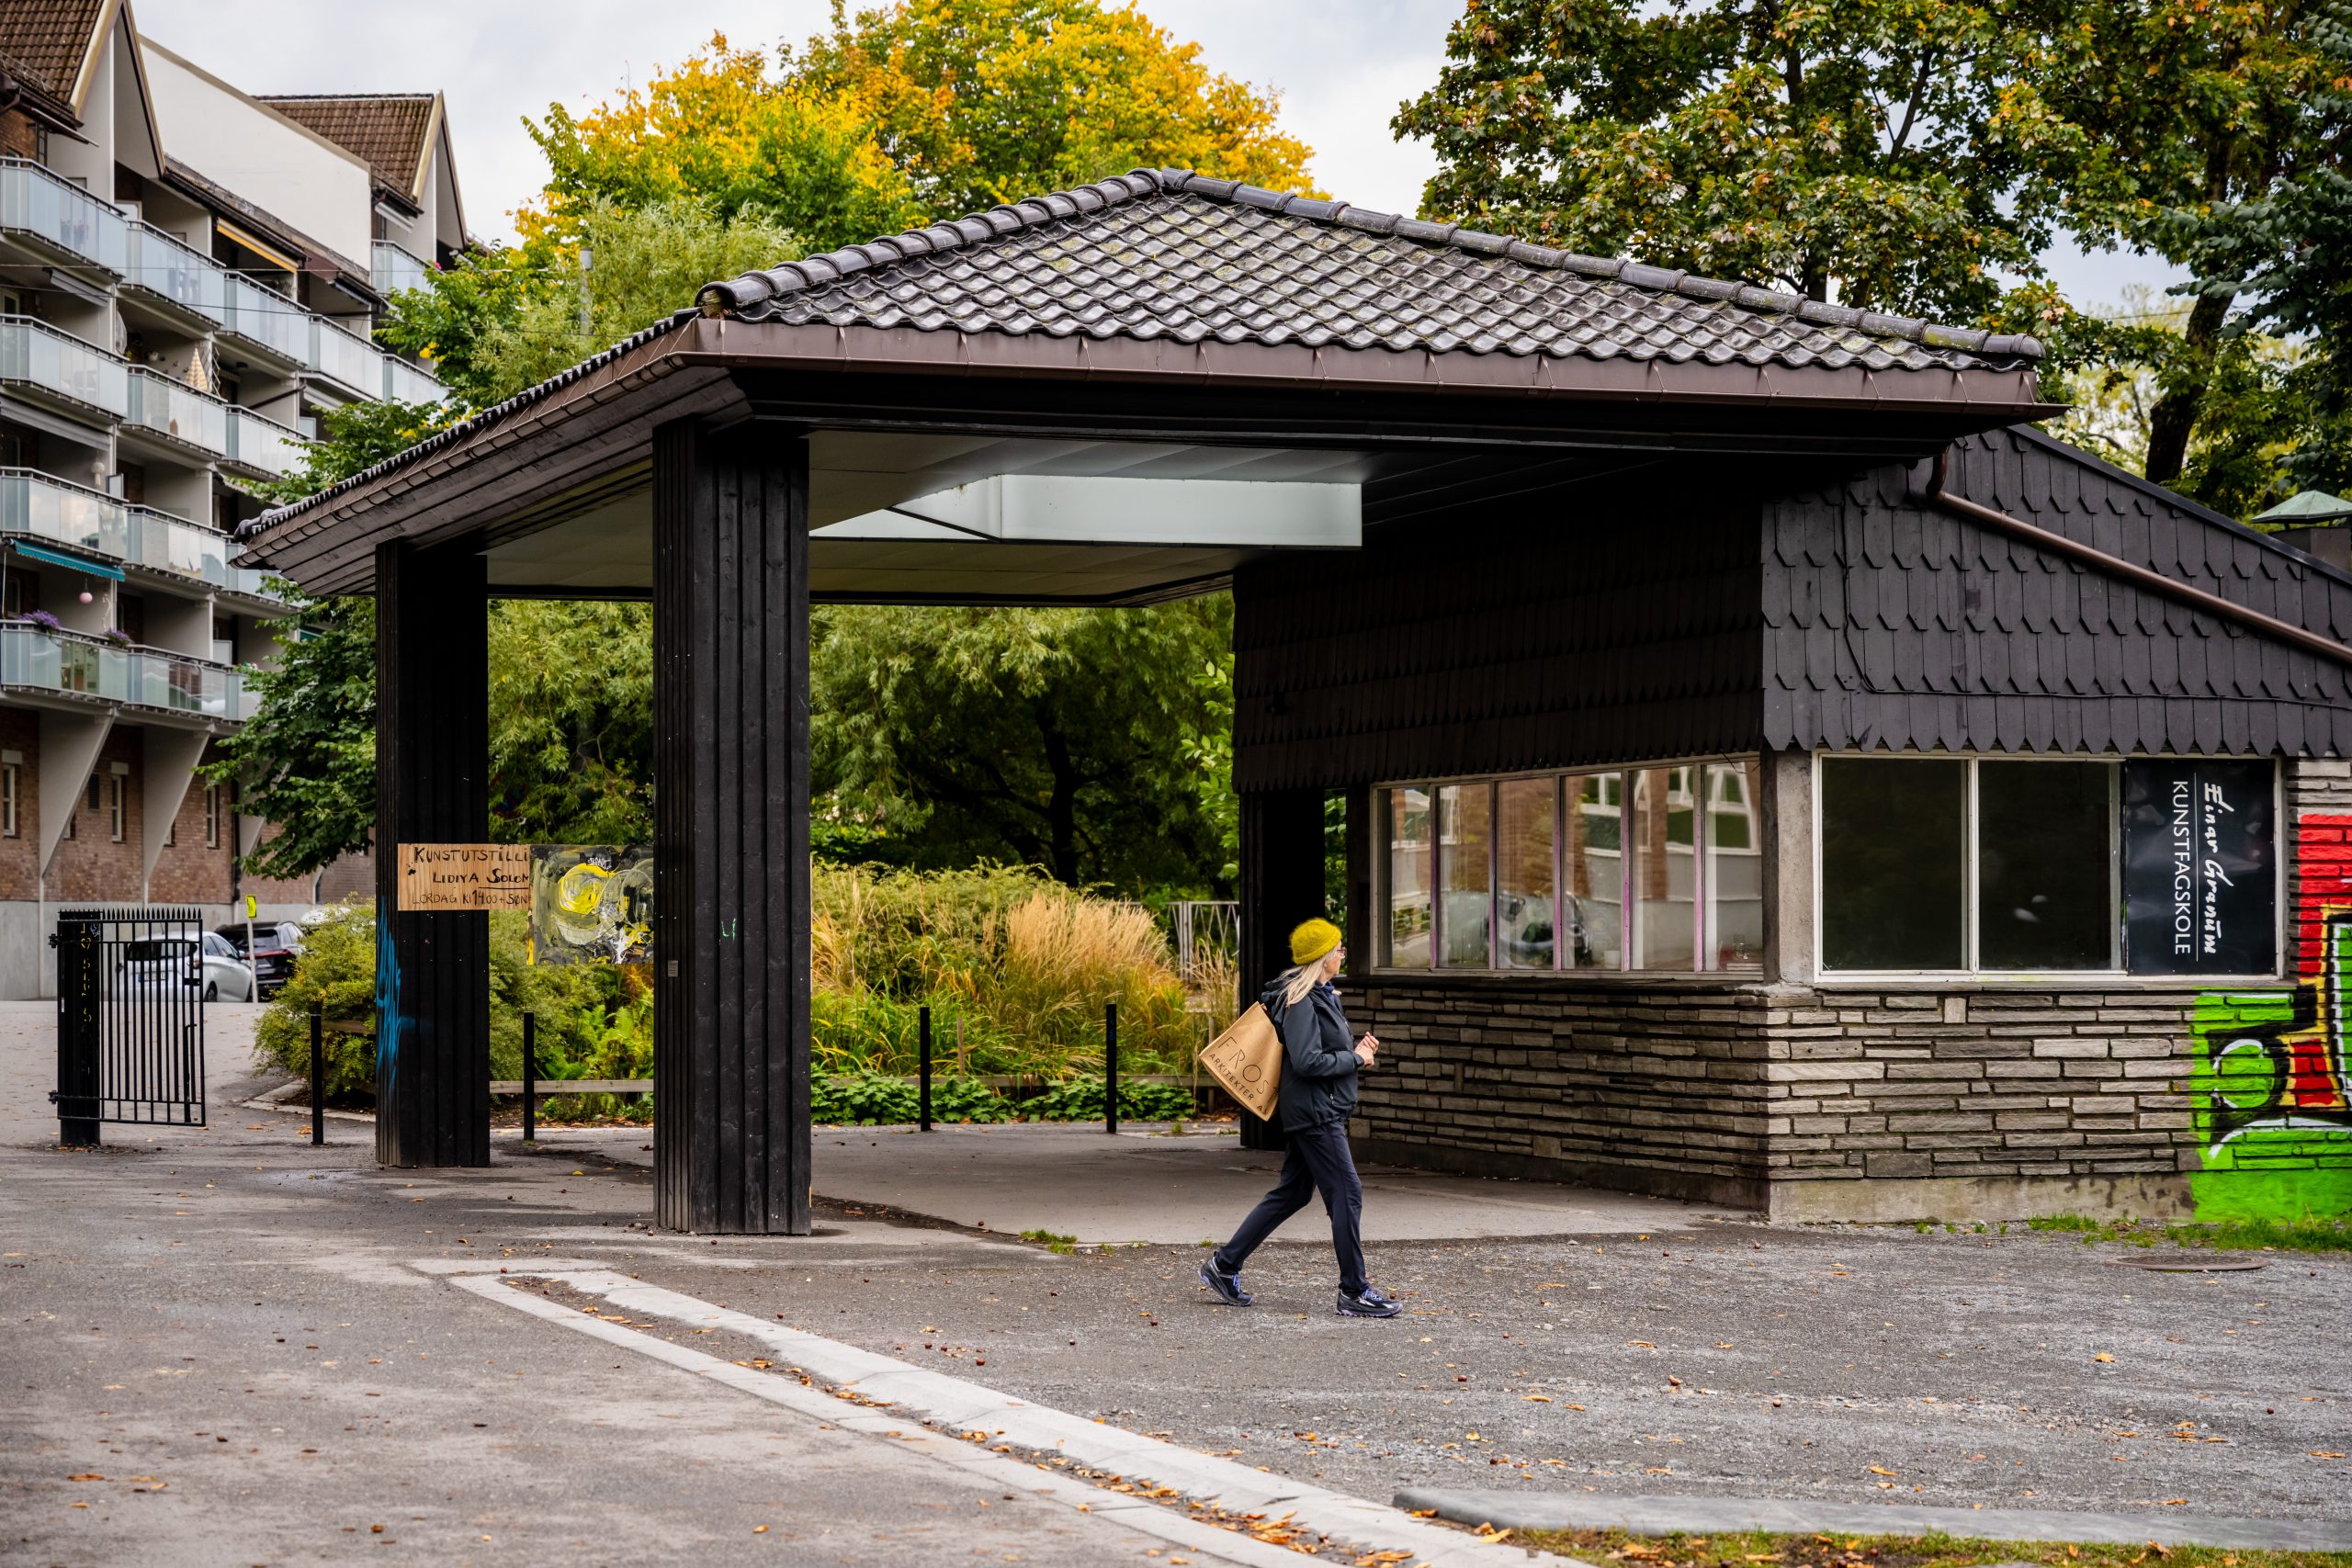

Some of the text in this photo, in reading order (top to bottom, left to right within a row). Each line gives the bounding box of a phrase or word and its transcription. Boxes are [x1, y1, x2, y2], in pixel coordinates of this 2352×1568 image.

[2204, 782, 2234, 853] Einar
[432, 872, 479, 884] LIDIYA
[2173, 781, 2191, 955] KUNSTFAGSKOLE
[1208, 1053, 1254, 1101] ARKITEKTER
